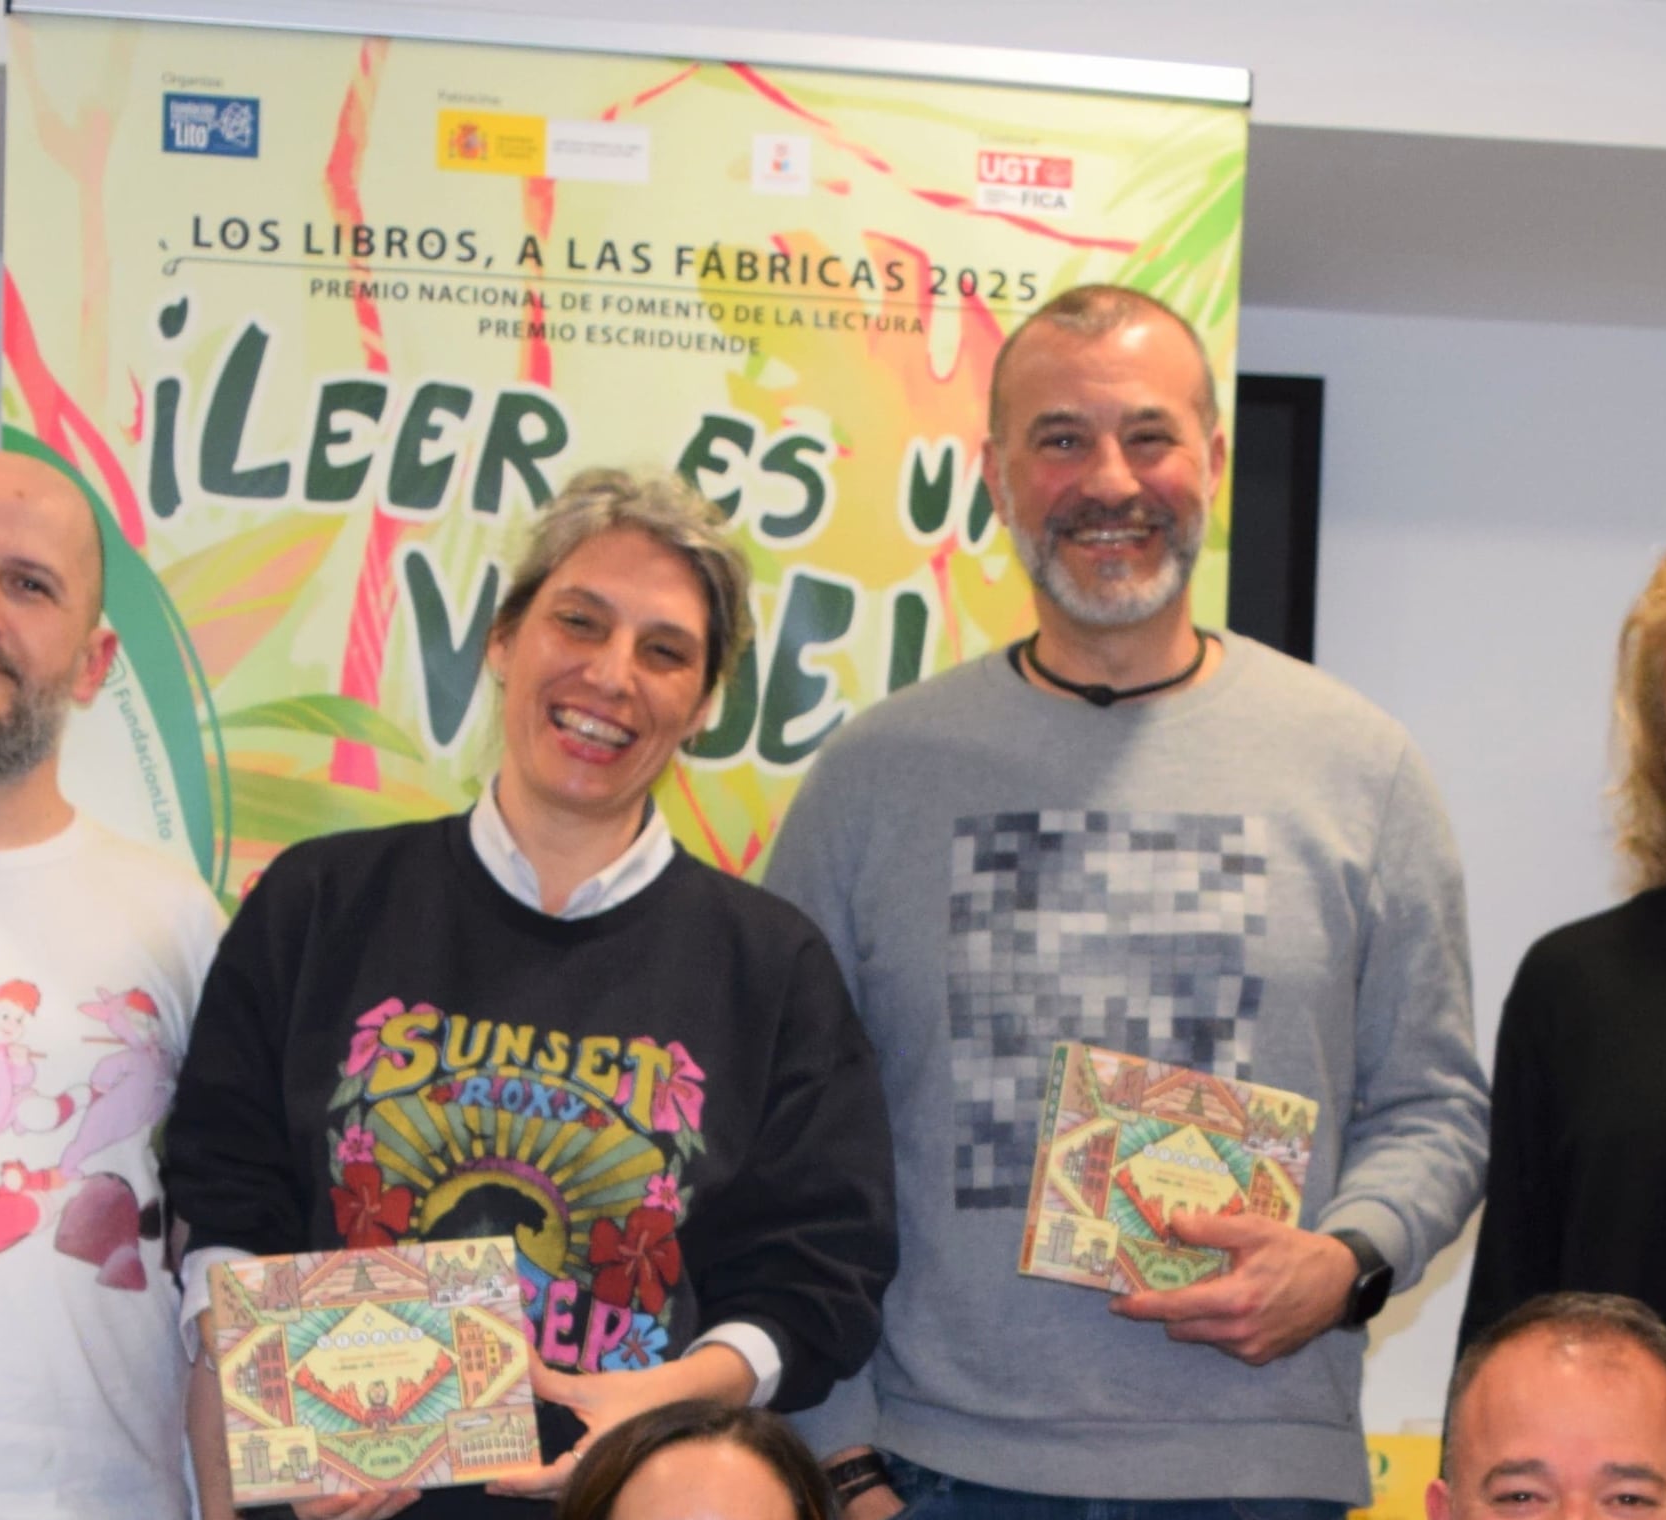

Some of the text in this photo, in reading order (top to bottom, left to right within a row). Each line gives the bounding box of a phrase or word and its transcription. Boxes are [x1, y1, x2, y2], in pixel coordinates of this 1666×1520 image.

[981, 154, 1041, 186] UGT
[1021, 188, 1068, 210] FICA
[192, 215, 1037, 301] LOS LIBROS, A LAS FÁBRICAS 2025
[309, 278, 926, 335] PREMIO NACIONAL DE FOMENTO DE LA LECTURA
[479, 317, 761, 354] PREMIO ESCRIDUENDE
[676, 413, 826, 539] ES
[365, 1012, 673, 1134] SUNSET
[458, 1076, 589, 1122] ROXY
